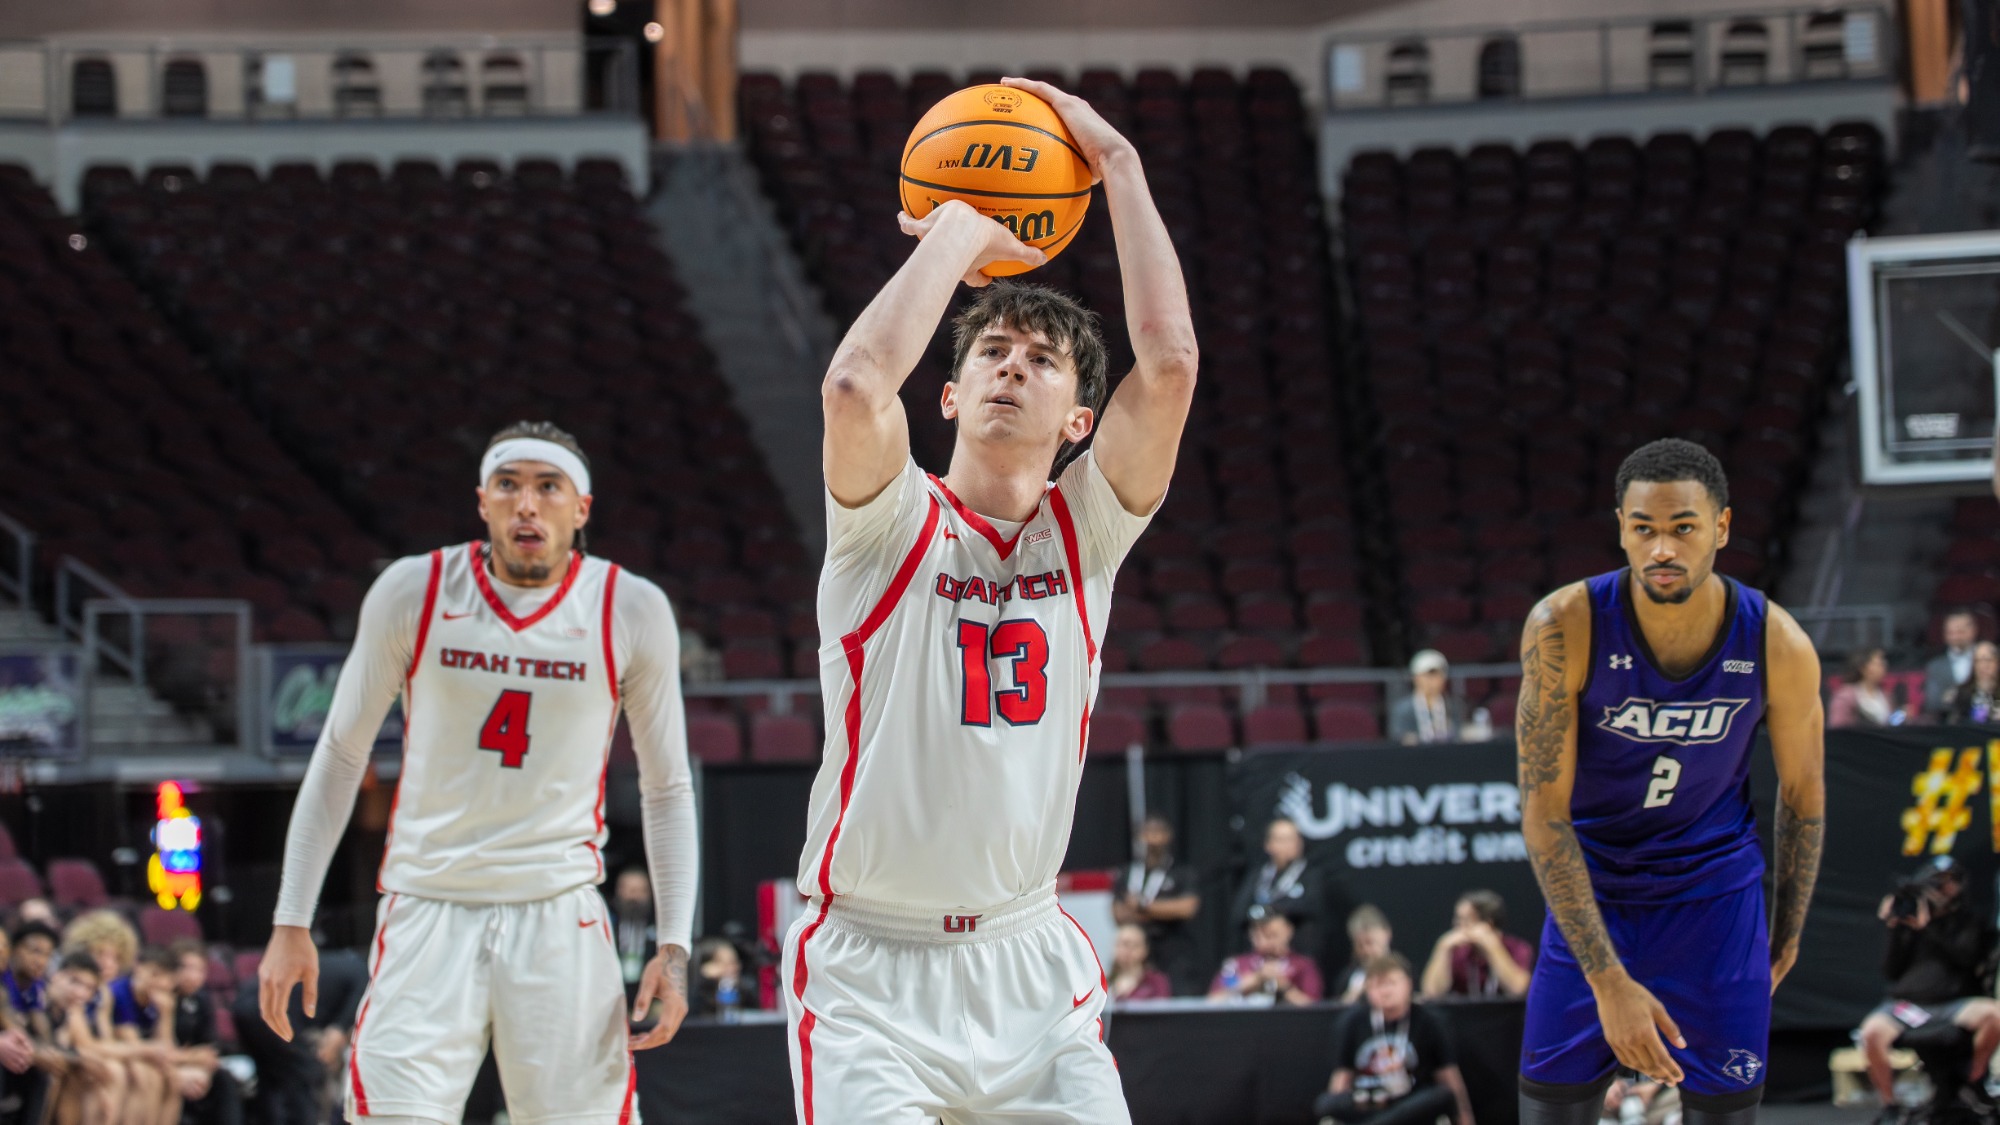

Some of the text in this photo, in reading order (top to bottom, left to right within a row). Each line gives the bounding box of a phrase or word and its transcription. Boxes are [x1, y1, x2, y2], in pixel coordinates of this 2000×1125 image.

[936, 143, 1040, 173] EVO NXT
[1024, 528, 1052, 544] WAC
[440, 648, 587, 682] UTAH TECH
[956, 617, 1050, 728] 13
[1722, 659, 1756, 674] WAC
[478, 688, 533, 769] 4
[1607, 702, 1734, 740] ACU
[1643, 754, 1682, 808] 2
[1280, 774, 1522, 840] UNIVER
[1345, 825, 1467, 869] credit
